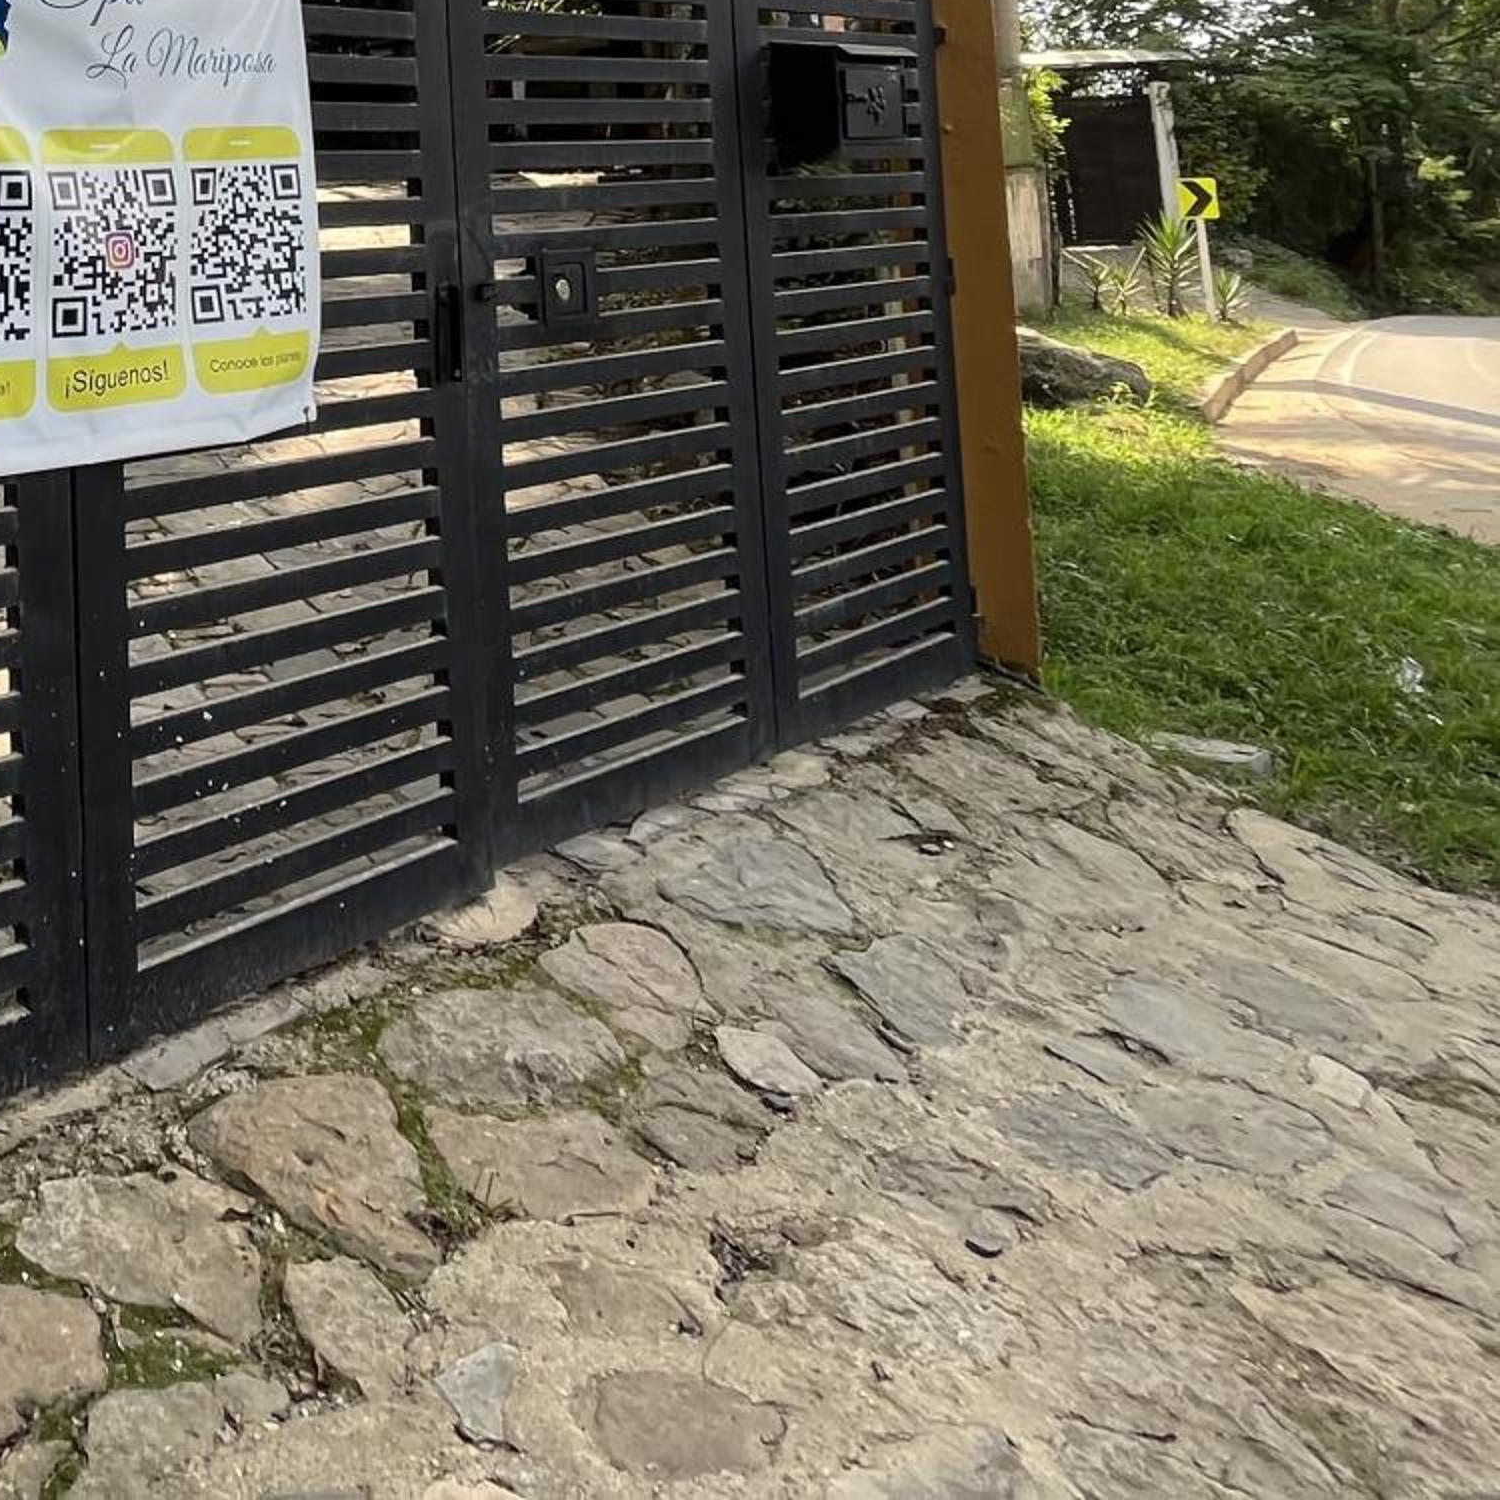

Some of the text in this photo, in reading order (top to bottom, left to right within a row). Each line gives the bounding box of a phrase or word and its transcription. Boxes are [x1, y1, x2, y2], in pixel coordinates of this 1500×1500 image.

[85, 24, 277, 89] La Mariposa
[65, 358, 169, 399] ¡Síguenos!
